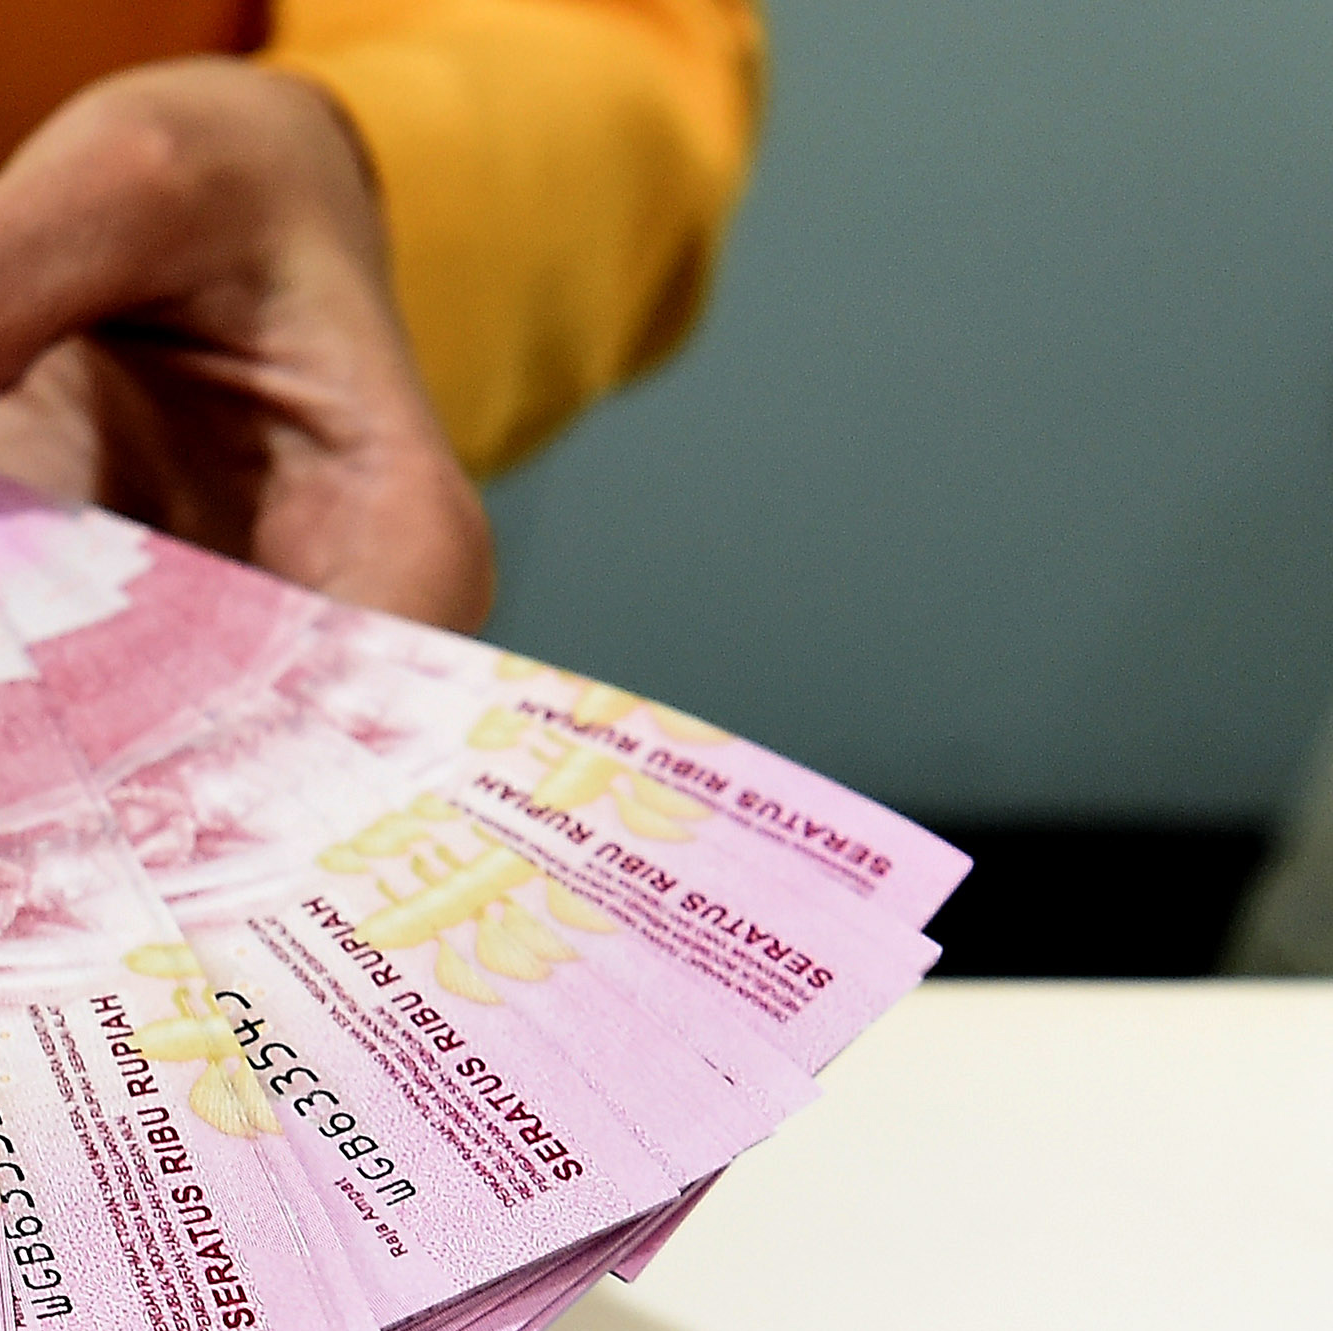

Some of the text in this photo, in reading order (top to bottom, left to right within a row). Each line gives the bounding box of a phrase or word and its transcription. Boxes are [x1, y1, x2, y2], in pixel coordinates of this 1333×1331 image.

[474, 774, 594, 845] RUPIAH
[594, 842, 677, 894] RIBU
[679, 892, 833, 989] SERATUS
[301, 896, 583, 1182] SERATUS RIBU RUPIAH
[89, 994, 256, 1331] SERATUS RIBU RUPIAH
[333, 1176, 408, 1258] Raja Ampat
